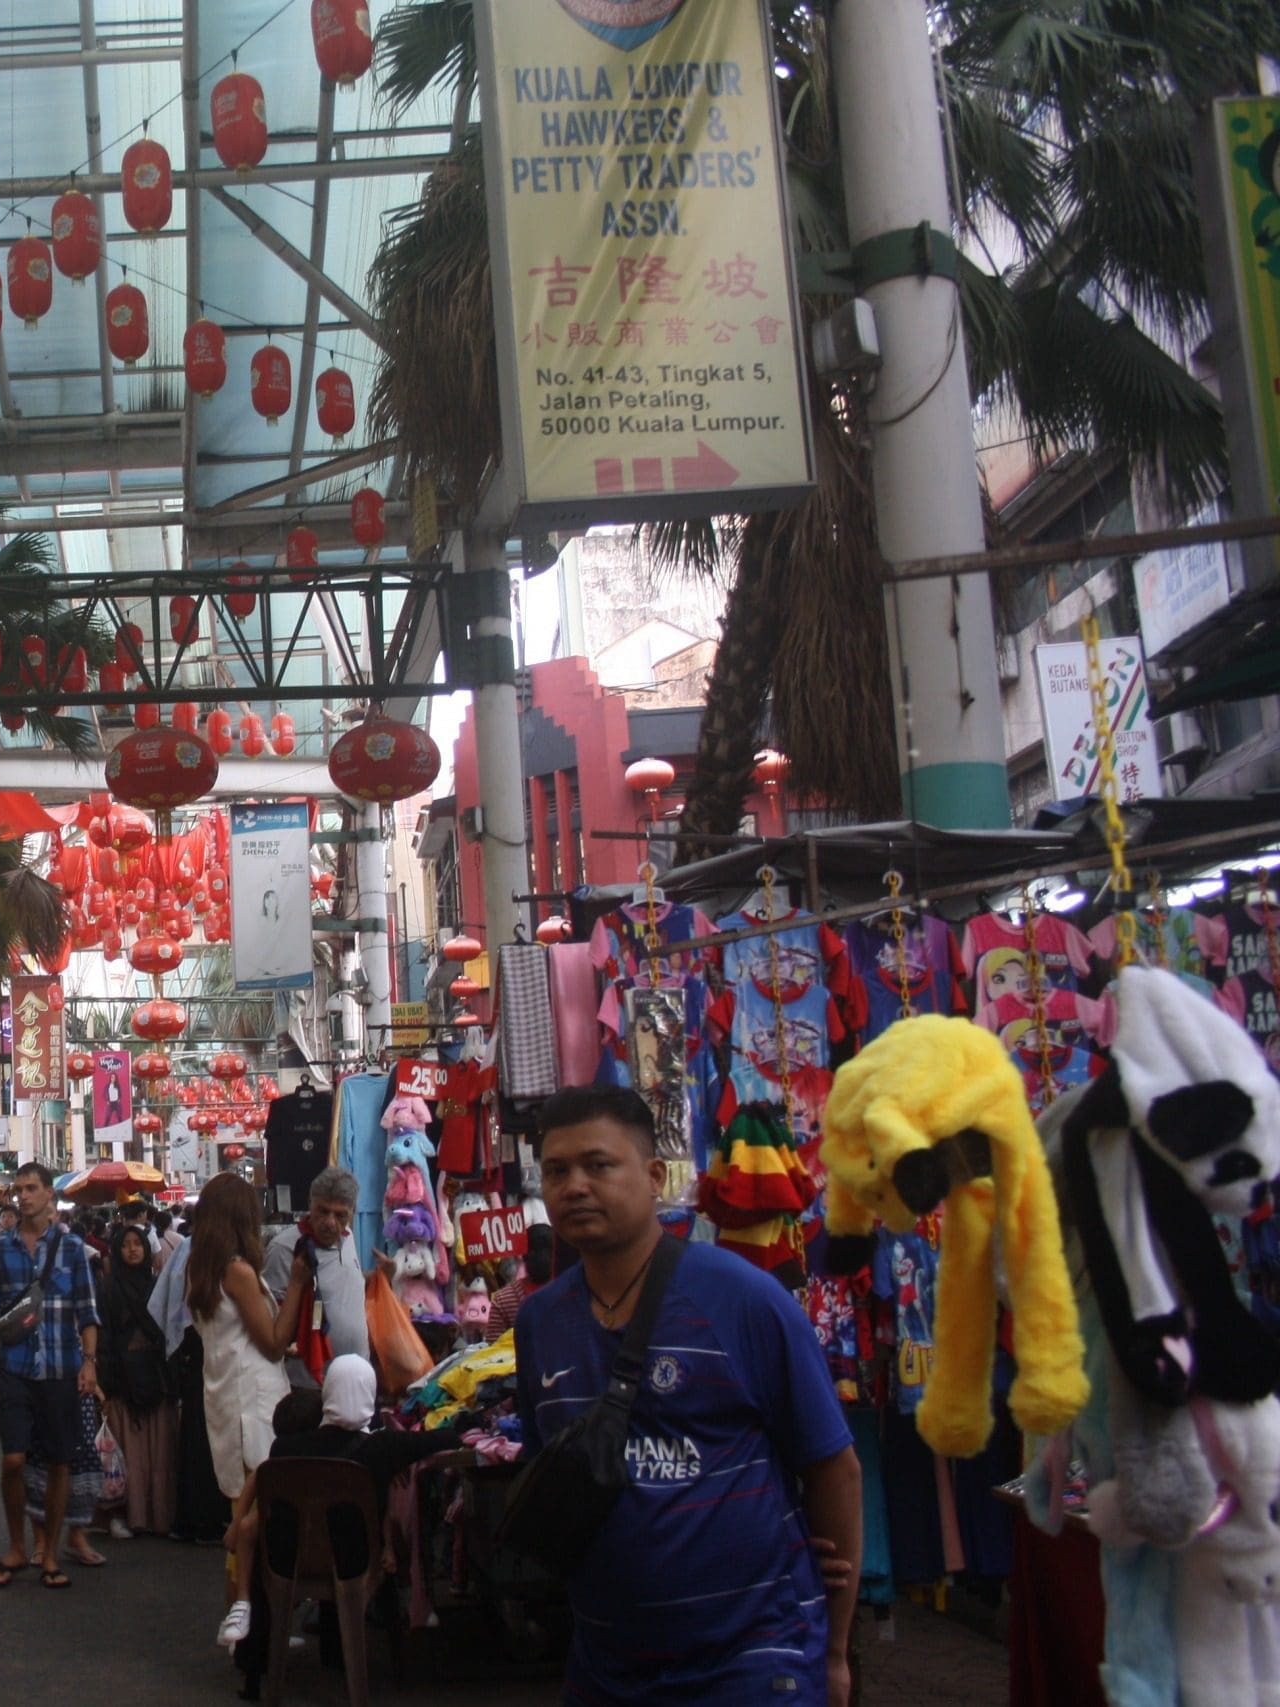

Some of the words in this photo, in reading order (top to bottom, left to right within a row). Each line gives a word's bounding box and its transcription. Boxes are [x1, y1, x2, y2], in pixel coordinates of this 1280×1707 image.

[514, 66, 613, 103] KUALA
[628, 61, 743, 99] LUMPUR
[706, 106, 729, 141] &
[512, 155, 604, 193] PETTY
[618, 146, 761, 189] TRADERS'
[601, 201, 688, 238] ASSN.
[528, 253, 769, 307] 吉隆坡
[522, 315, 786, 350] 小販商業公會
[536, 368, 574, 386] No.
[582, 366, 649, 386] 41-43,
[657, 363, 744, 386] Tingkat
[753, 363, 772, 384] 5,
[539, 393, 601, 410] Jalan
[608, 390, 711, 411] Petaling,
[541, 417, 610, 435] 50000
[619, 416, 684, 434] Kuala
[692, 414, 785, 434] Lumpur.
[1047, 664, 1077, 678] KEDAI
[1050, 679, 1089, 694] BUTANG
[1115, 731, 1147, 744] BUTTON
[1117, 745, 1139, 757] SHOP
[241, 848, 280, 856] ZHEN-AO
[480, 1211, 523, 1254] 10.00
[636, 1461, 702, 1479] TYRES
